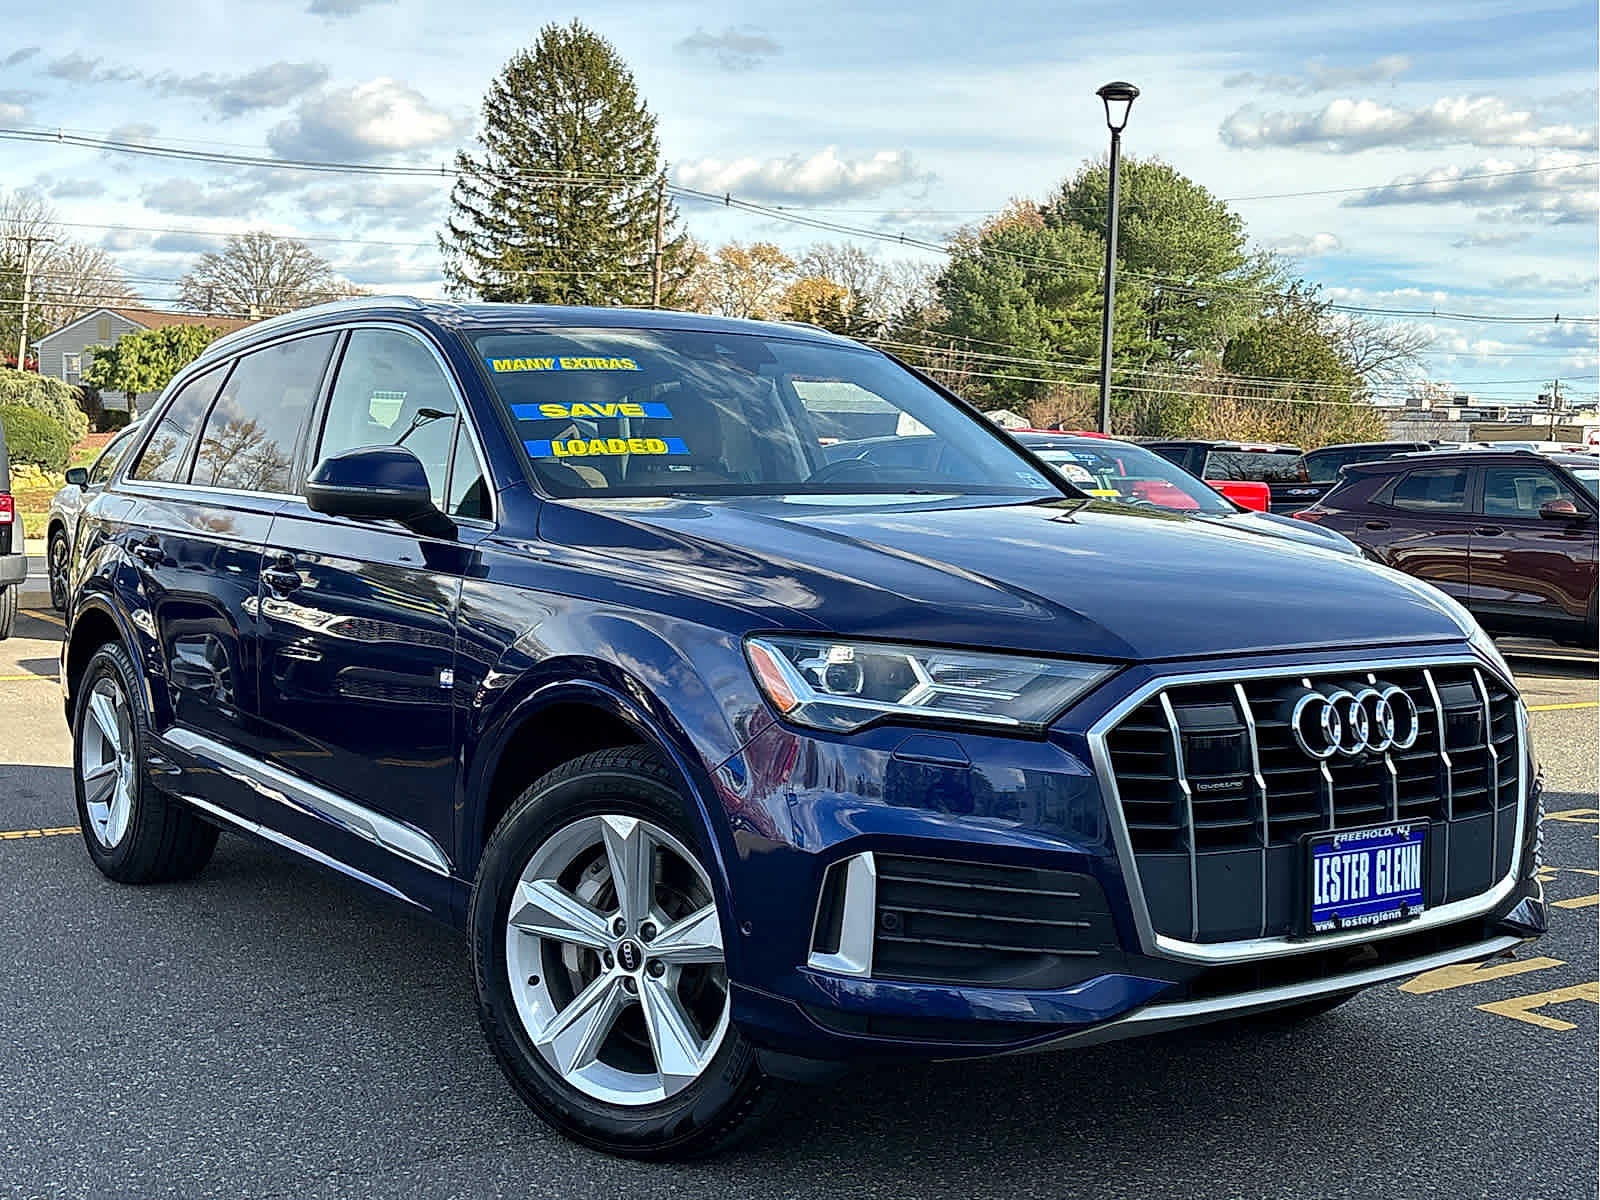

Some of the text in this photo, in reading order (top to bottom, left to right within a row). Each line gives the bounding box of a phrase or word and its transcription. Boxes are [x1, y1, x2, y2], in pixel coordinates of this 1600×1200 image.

[492, 357, 636, 373] MANY EXTRAS
[538, 403, 646, 418] SAVE
[551, 438, 669, 457] LOADED
[1314, 844, 1421, 905] LESTER GLENN
